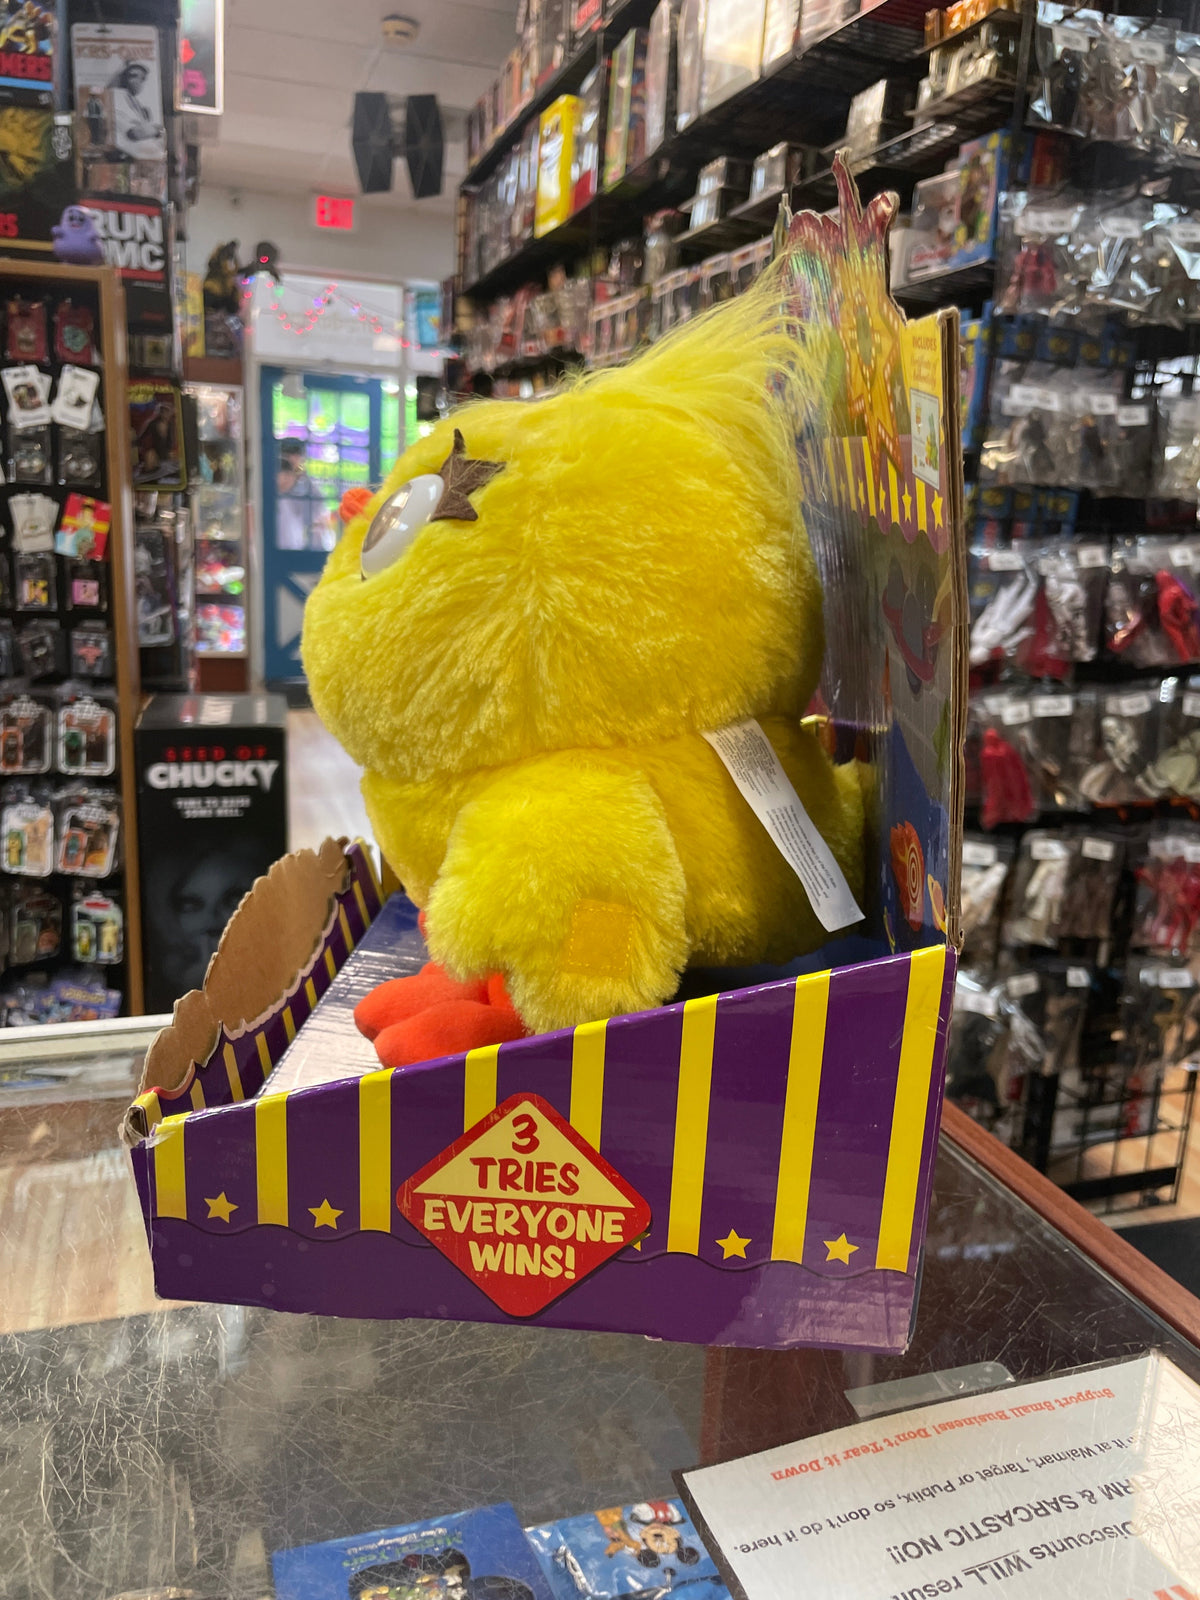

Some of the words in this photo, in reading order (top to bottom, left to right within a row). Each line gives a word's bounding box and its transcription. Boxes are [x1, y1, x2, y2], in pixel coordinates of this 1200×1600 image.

[146, 759, 279, 793] CHUCKY
[511, 1113, 540, 1154] 3
[469, 1157, 580, 1196] TRIES
[423, 1199, 626, 1244] EVERYONE
[468, 1240, 576, 1280] WINS!
[1055, 1388, 1115, 1408] Support
[1009, 1400, 1055, 1418] Small
[932, 1410, 1011, 1435] Business!
[883, 1427, 932, 1448] Don't
[1094, 1442, 1112, 1454] at
[1111, 1438, 1128, 1449] it
[824, 1454, 842, 1467] it
[843, 1441, 884, 1460] Tear
[1027, 1447, 1097, 1469] Walmart,
[770, 1459, 824, 1481] Down
[958, 1473, 976, 1485] or
[980, 1462, 1029, 1482] Target
[898, 1480, 957, 1503] Publix,
[1076, 1488, 1098, 1505] &
[874, 1499, 896, 1513] so
[799, 1521, 824, 1536] do
[826, 1507, 871, 1530] don't
[943, 1494, 1080, 1547] SARCASTIC
[733, 1533, 783, 1554] here.
[783, 1529, 799, 1543] it
[1029, 1519, 1143, 1561] Discounts
[886, 1534, 944, 1565] NO!!
[963, 1551, 1033, 1586] WILL
